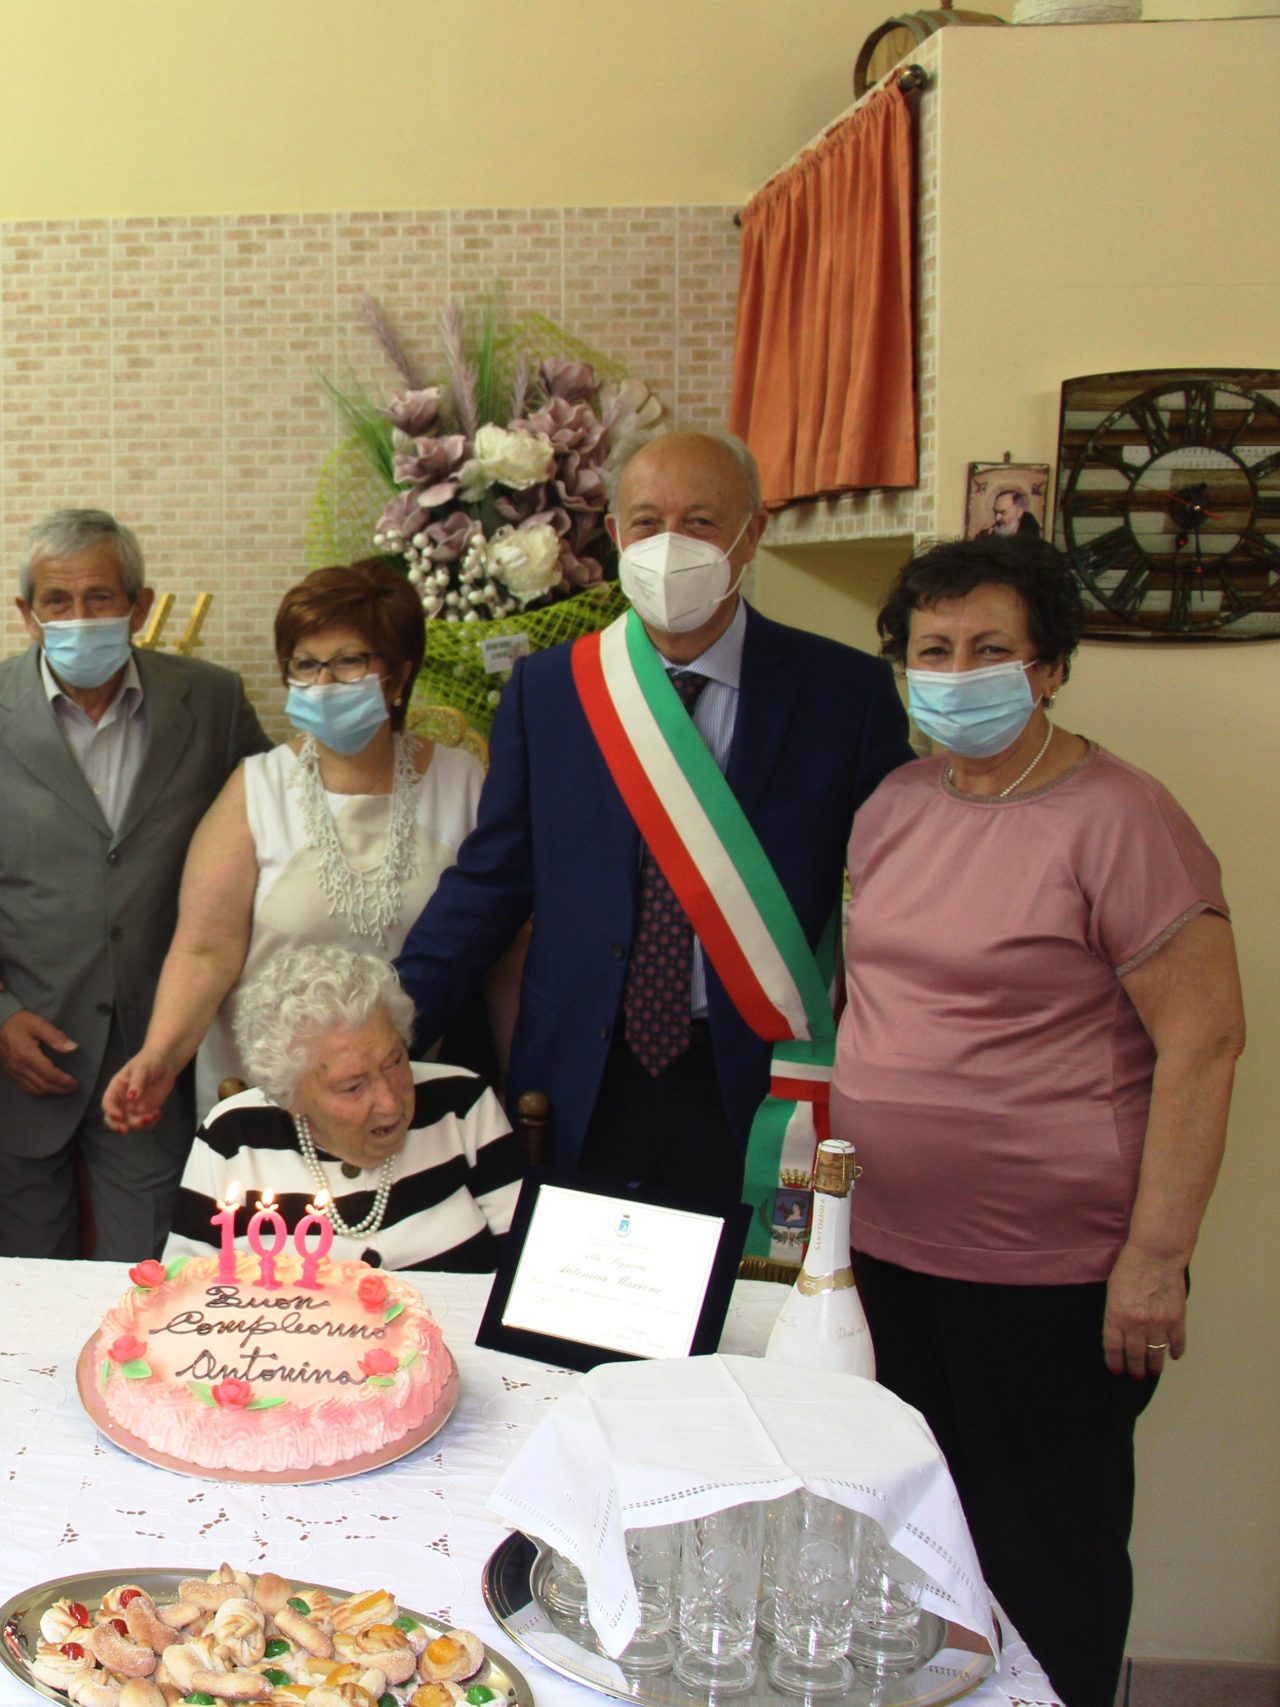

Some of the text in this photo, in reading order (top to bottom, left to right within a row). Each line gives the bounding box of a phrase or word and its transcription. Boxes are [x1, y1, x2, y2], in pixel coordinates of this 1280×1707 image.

[210, 1200, 334, 1290] 100
[554, 1262, 609, 1284] Antonina
[205, 1285, 332, 1309] Buon
[175, 1346, 370, 1387] Antonina
